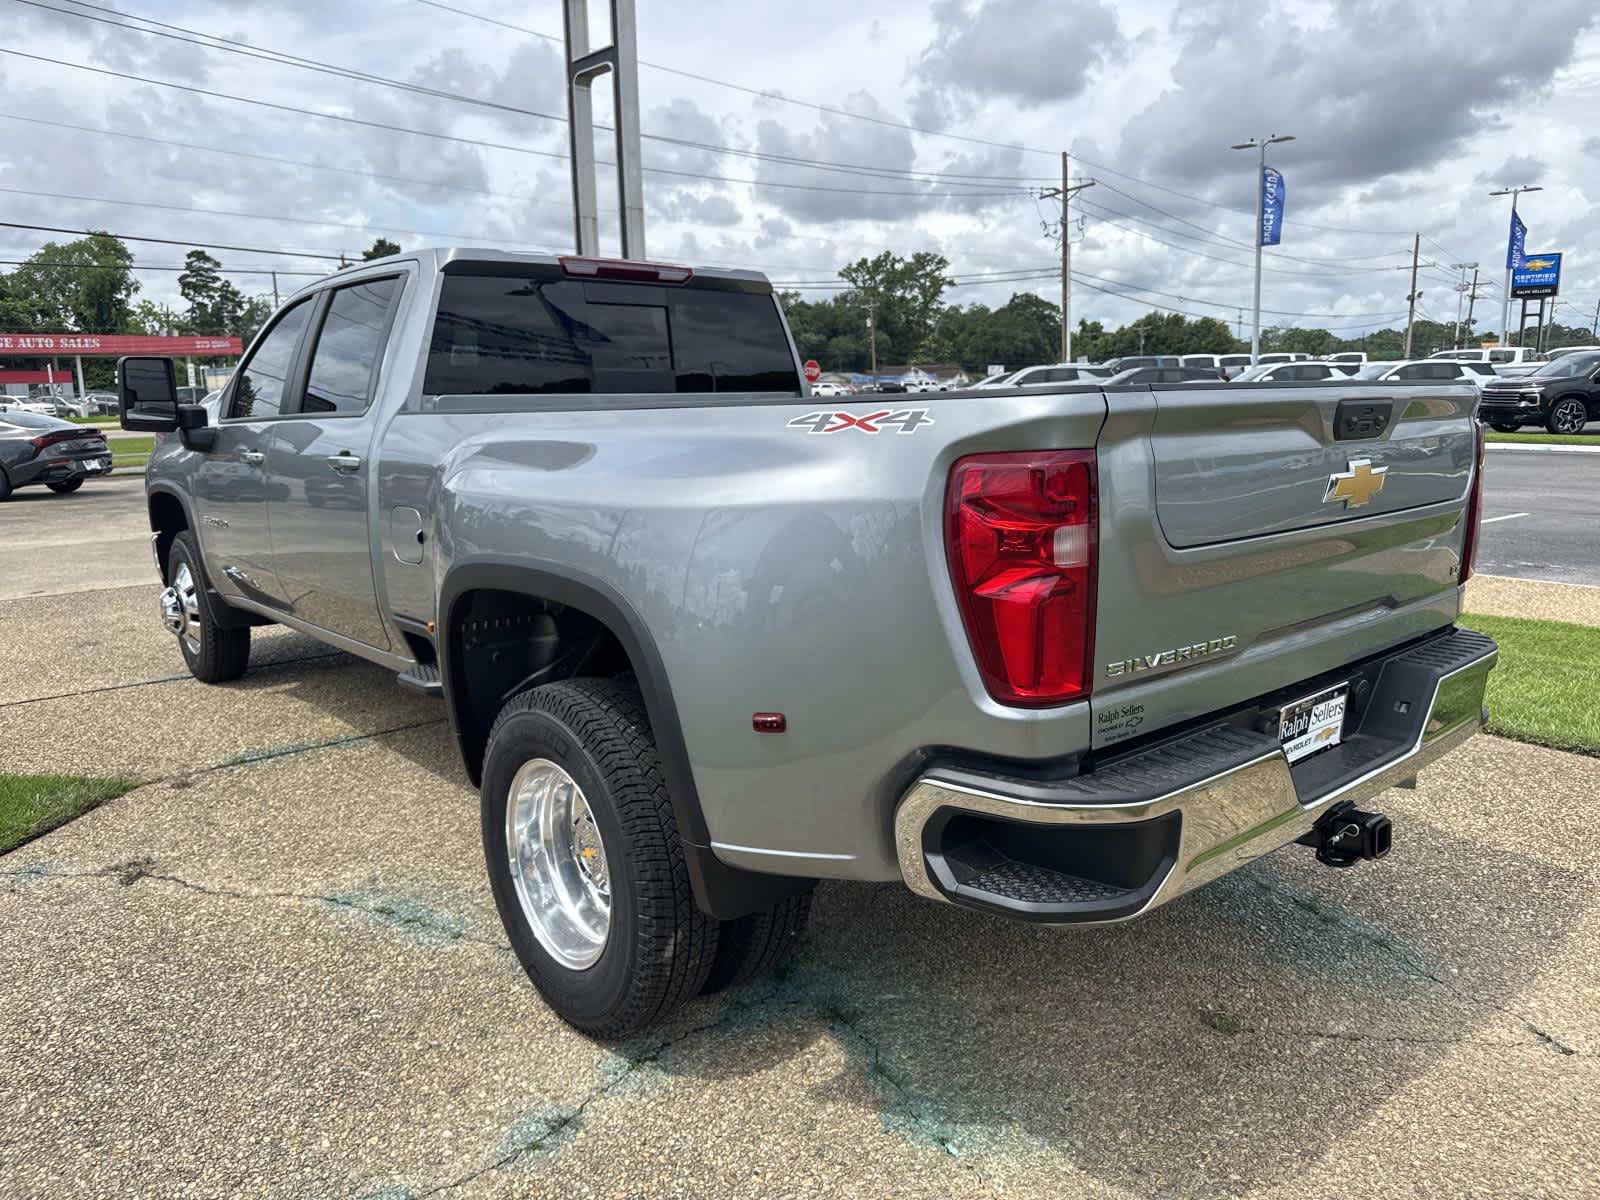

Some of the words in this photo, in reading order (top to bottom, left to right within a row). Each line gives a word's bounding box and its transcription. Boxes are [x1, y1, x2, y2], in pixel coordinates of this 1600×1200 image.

[18, 337, 54, 349] AUTO
[60, 337, 101, 349] SALES
[1106, 635, 1238, 677] SILVERADO
[1098, 707, 1119, 724] Ralph
[1120, 704, 1145, 717] Sellers
[1280, 711, 1309, 740] Ralph
[1312, 702, 1344, 725] Sellers
